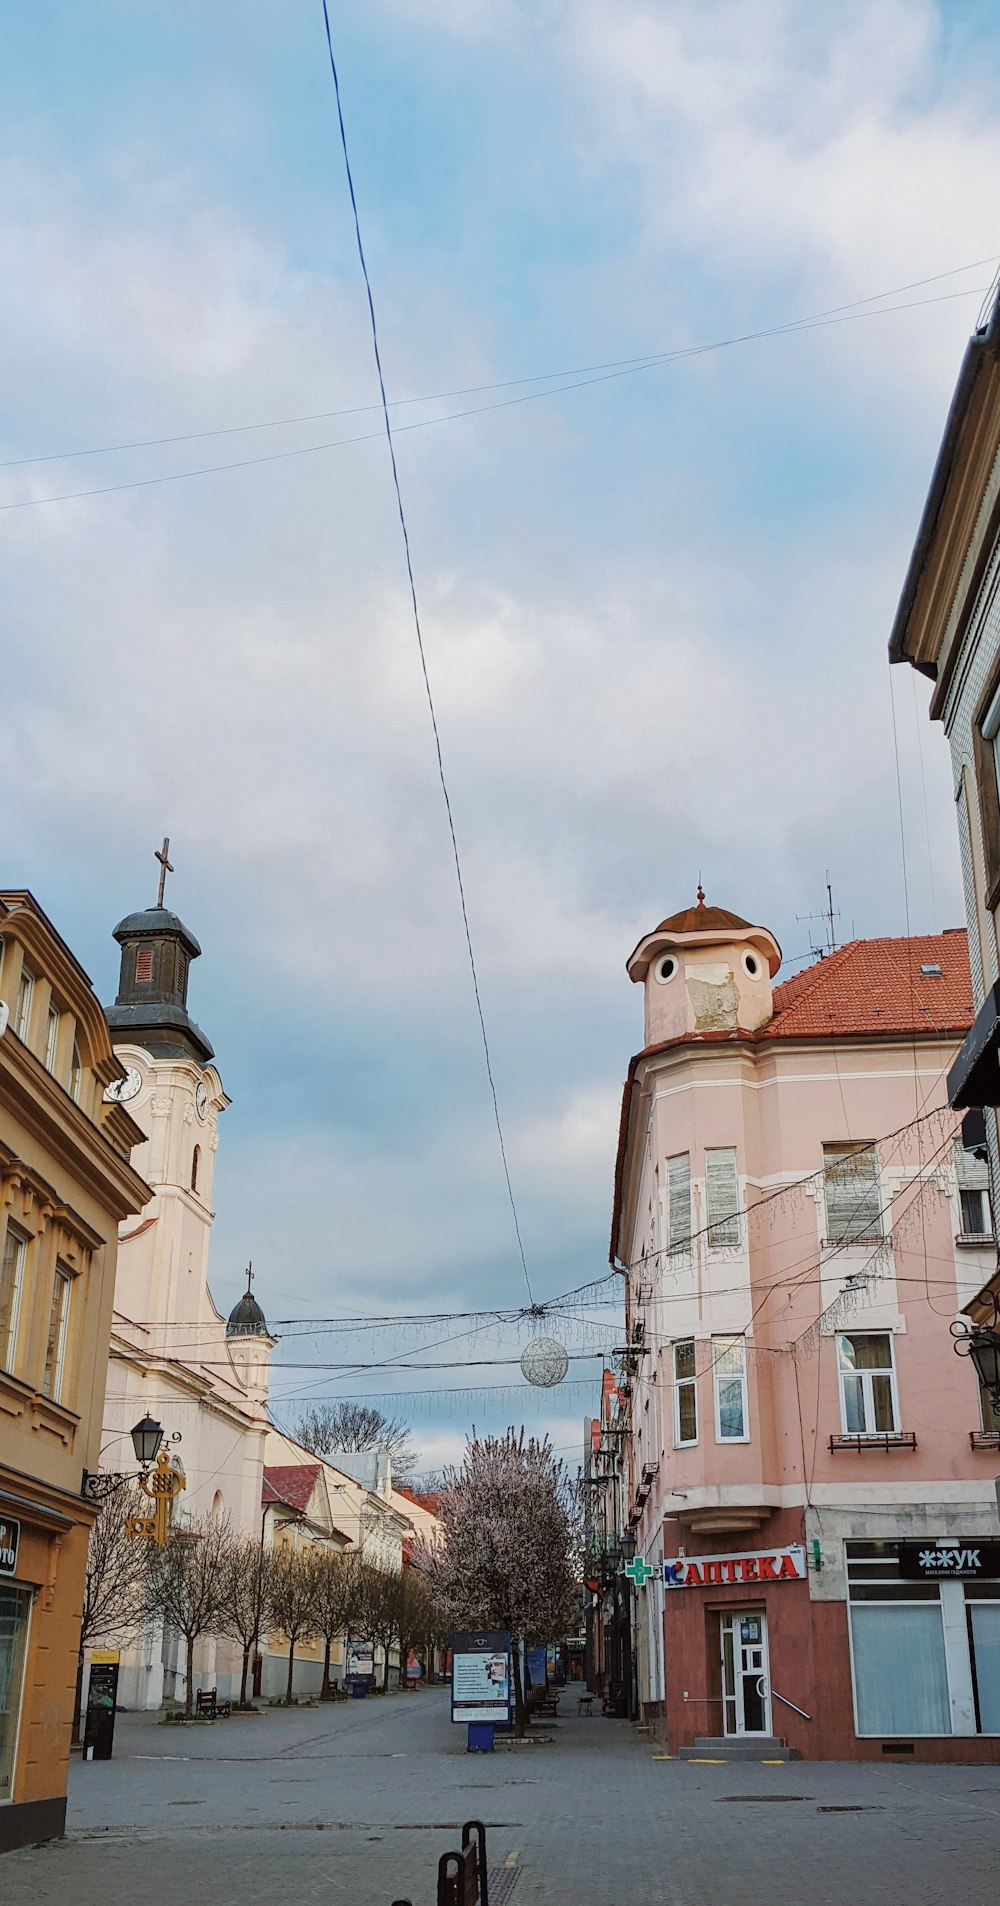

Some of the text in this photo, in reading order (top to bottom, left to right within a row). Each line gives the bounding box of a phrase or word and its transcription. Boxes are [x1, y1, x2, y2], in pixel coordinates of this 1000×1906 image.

[0, 1547, 14, 1565] ТО
[918, 1550, 982, 1569] ЖЖУК
[683, 1555, 799, 1585] АПТЕКА
